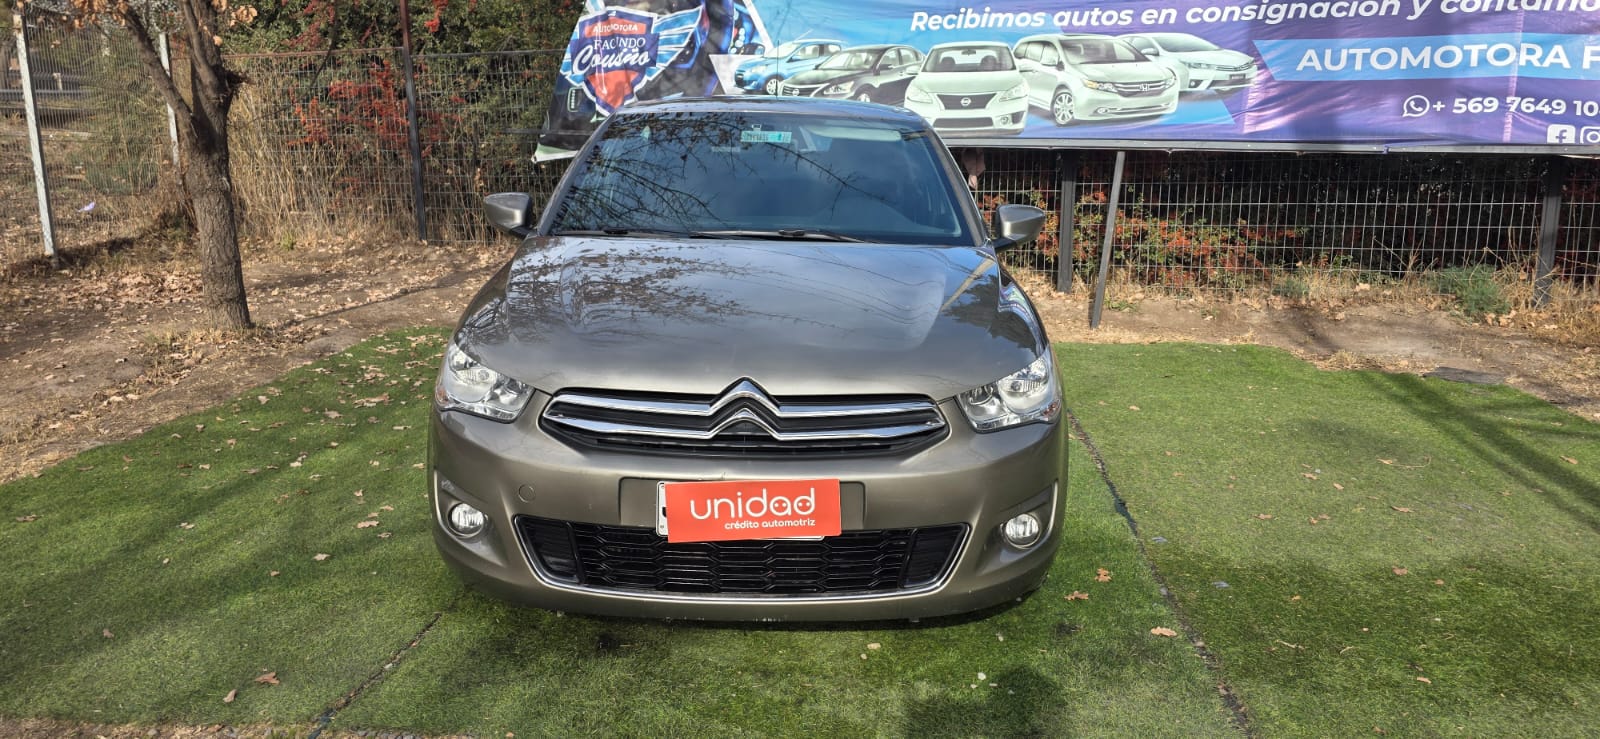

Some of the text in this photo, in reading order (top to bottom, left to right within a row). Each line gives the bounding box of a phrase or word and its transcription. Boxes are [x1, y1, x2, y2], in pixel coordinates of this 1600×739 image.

[910, 7, 1047, 31] Recibimos
[1053, 8, 1132, 26] autos
[1141, 6, 1177, 24] en
[1406, 0, 1433, 21] y
[594, 37, 646, 50] FACNDO
[1296, 43, 1571, 71] AUTOMOTORA
[1452, 96, 1499, 113] 569
[1506, 96, 1567, 115] 7649
[1573, 100, 1600, 117] 10
[690, 487, 816, 520] unidad
[724, 518, 816, 530] crédito automotriz
